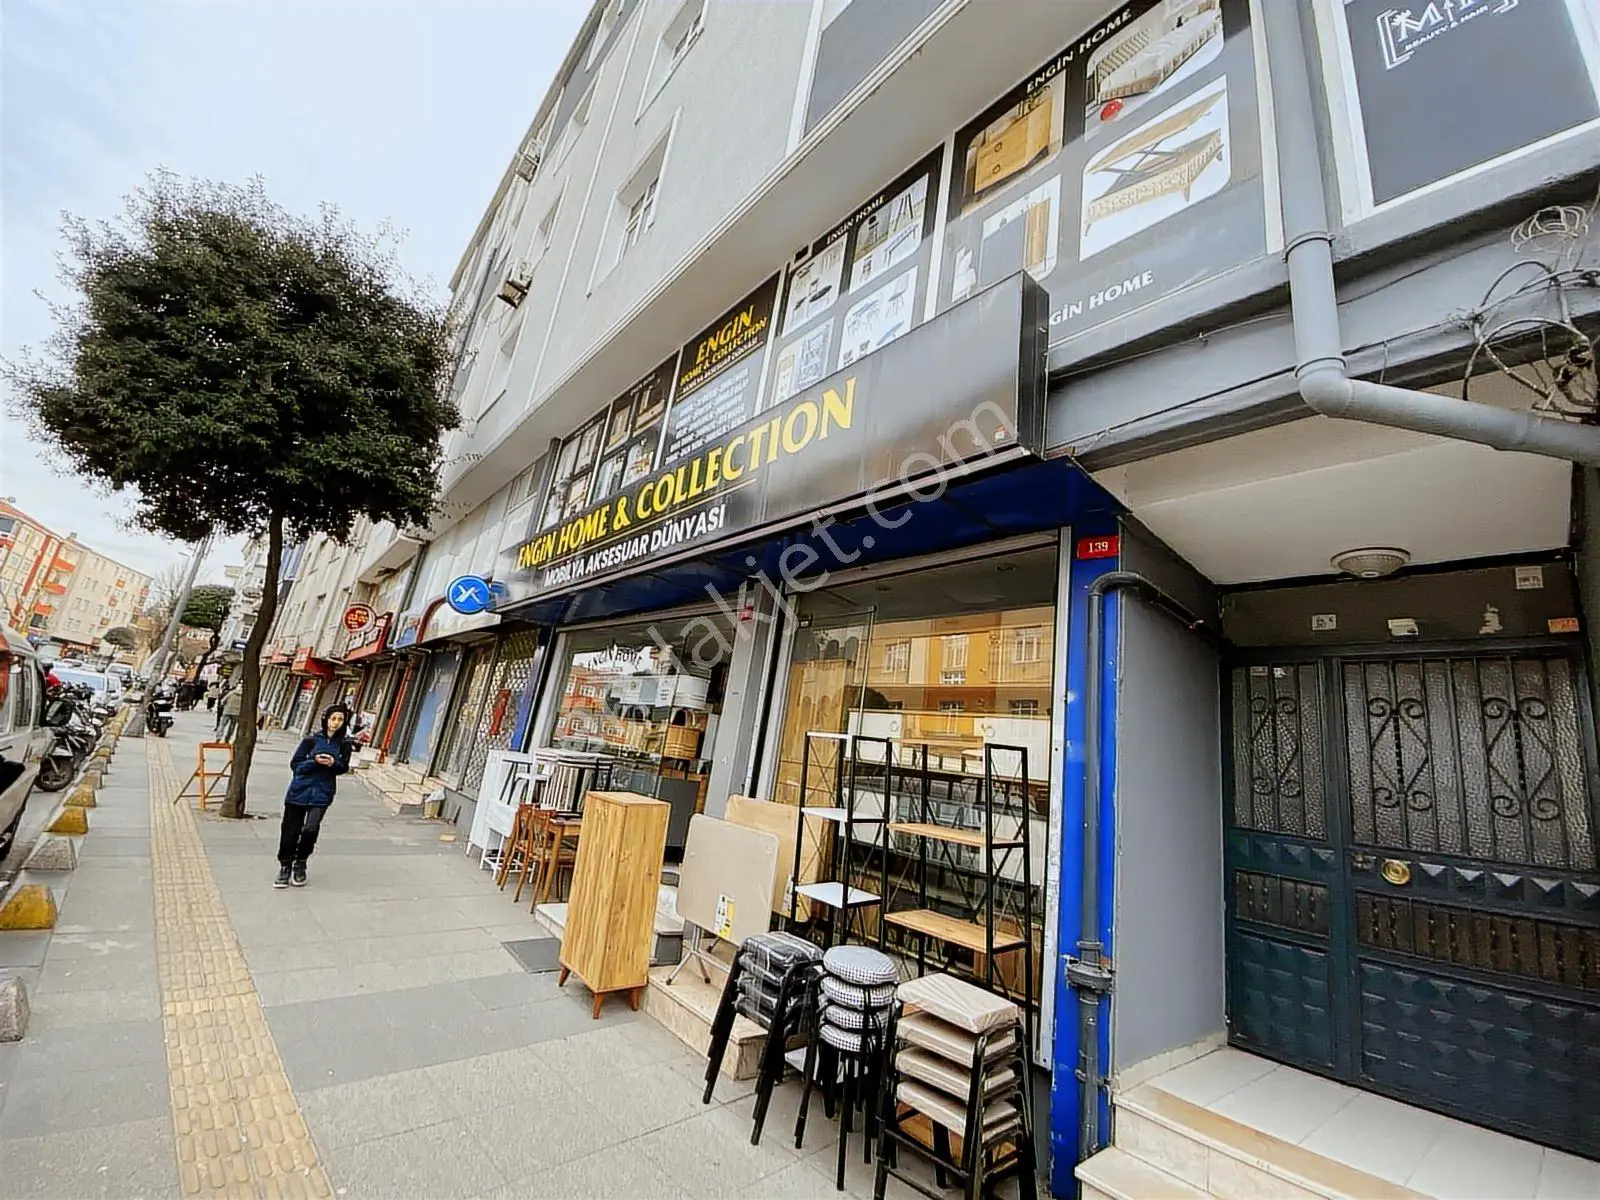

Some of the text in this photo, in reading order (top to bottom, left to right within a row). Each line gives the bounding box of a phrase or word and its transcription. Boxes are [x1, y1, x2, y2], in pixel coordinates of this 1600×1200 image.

[1079, 8, 1132, 54] HOME
[1089, 270, 1155, 309] HOME
[516, 531, 557, 572] ENGİN
[557, 505, 610, 555] HOME
[613, 496, 631, 530] &
[636, 376, 857, 521] COLLECTION
[543, 503, 726, 588] MOBİLYA AKSESUAR DÜNYASI
[1088, 541, 1109, 553] 139
